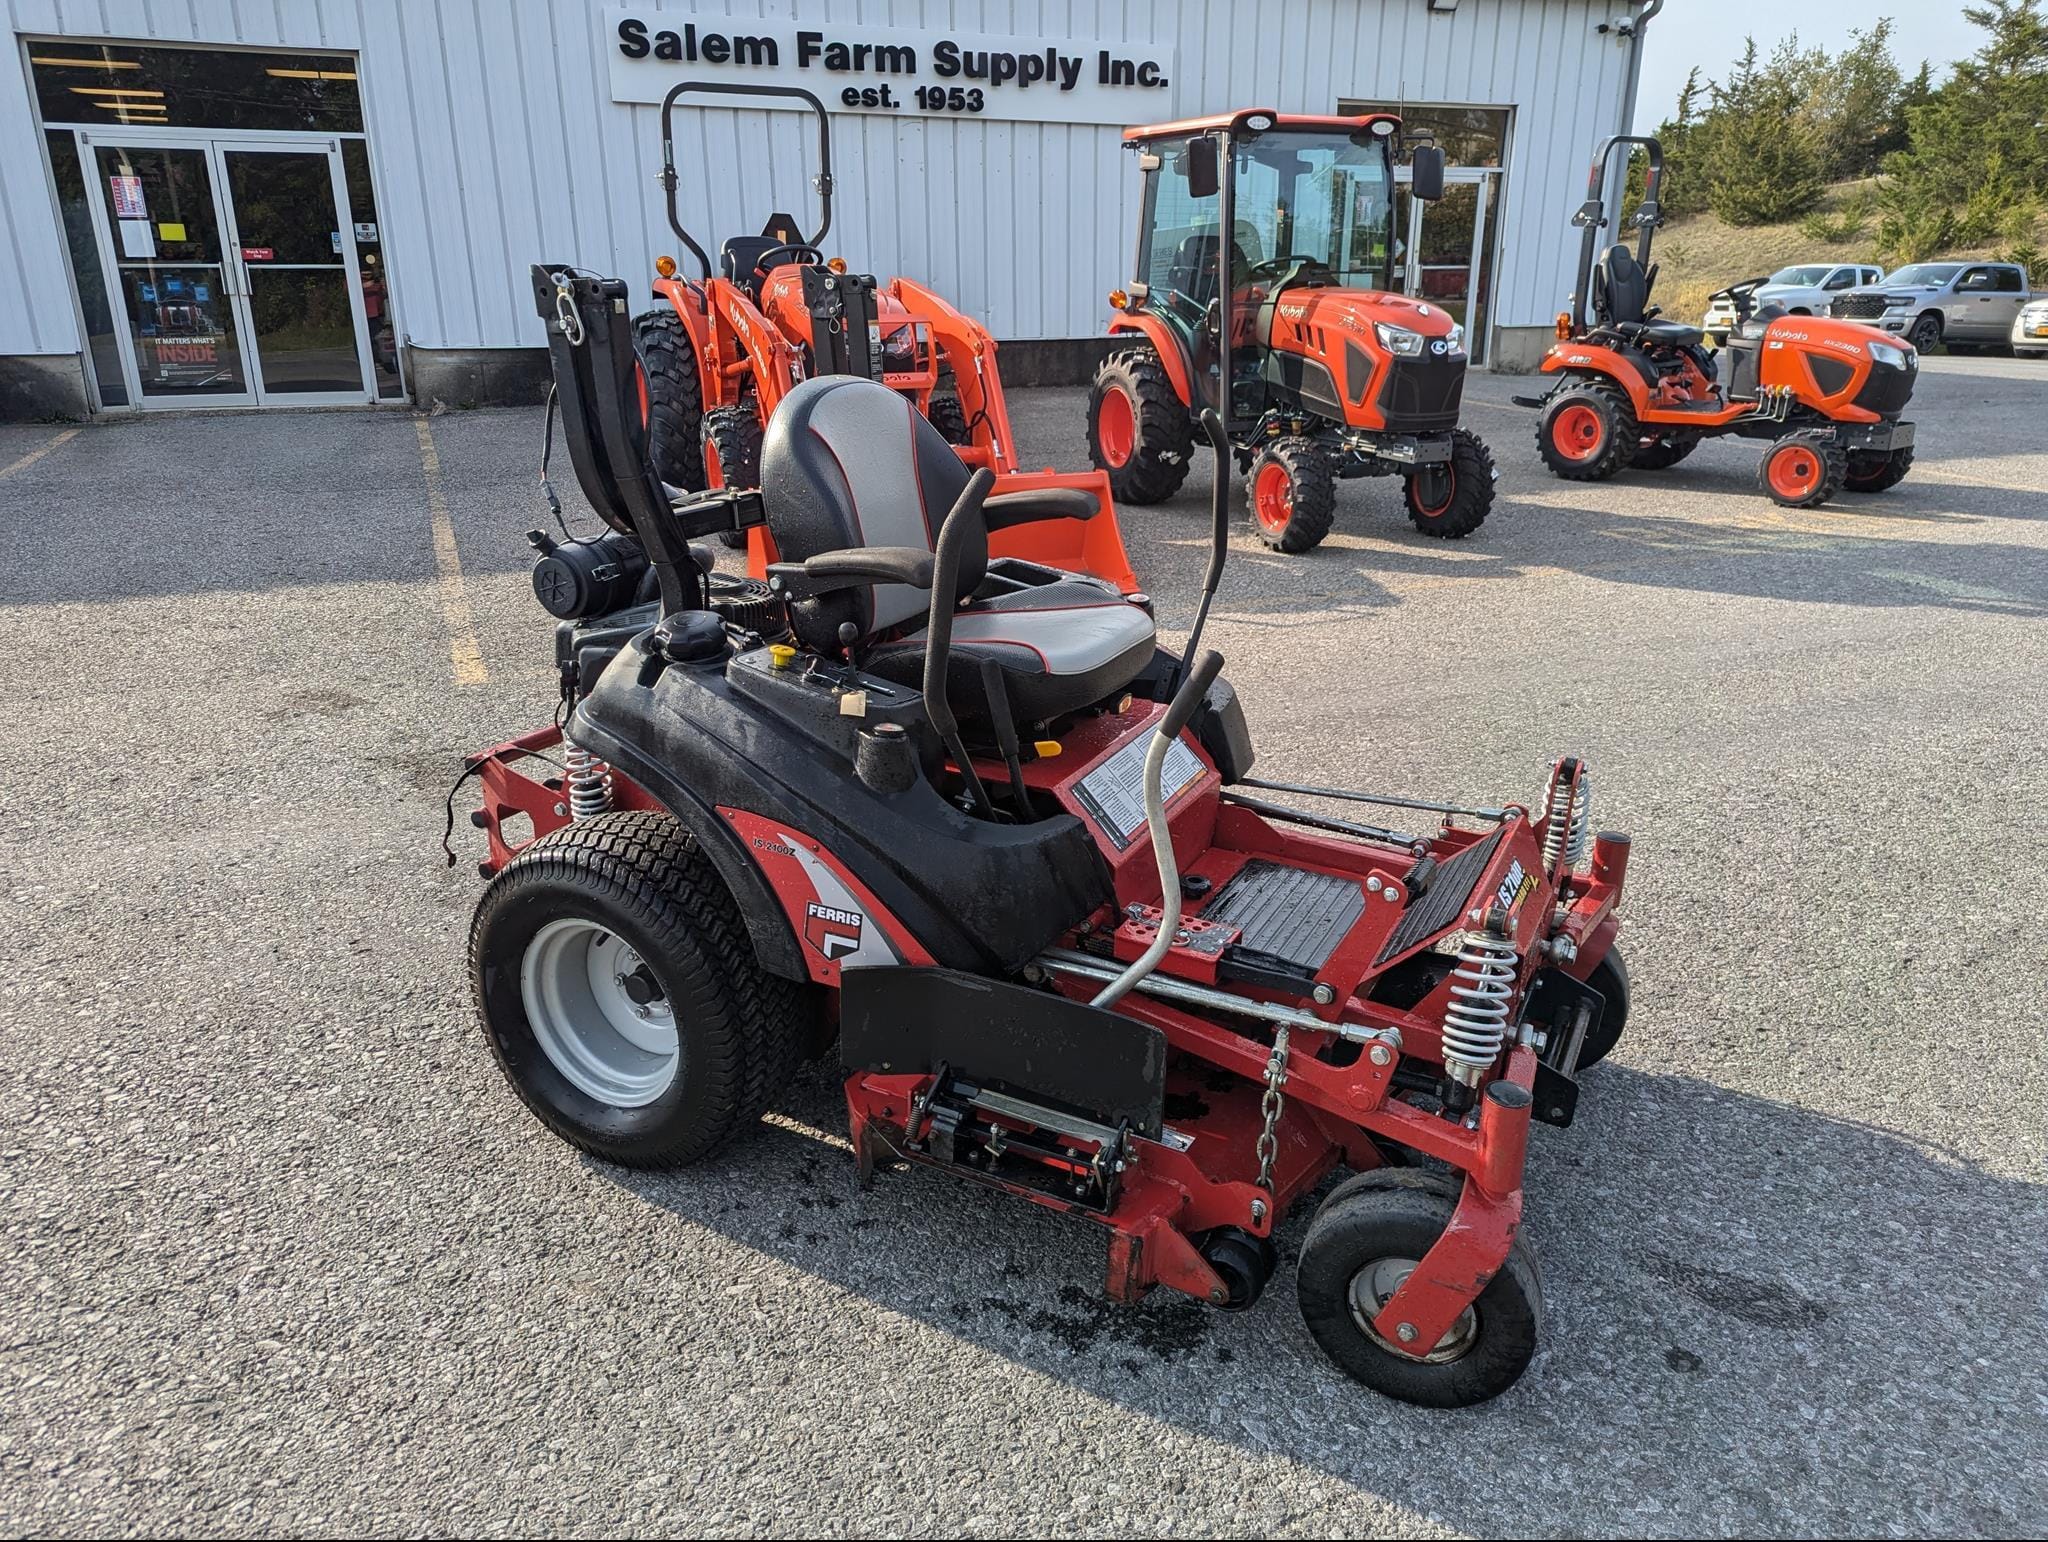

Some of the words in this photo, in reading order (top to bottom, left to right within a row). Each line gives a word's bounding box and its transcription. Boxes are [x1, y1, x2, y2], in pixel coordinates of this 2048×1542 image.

[618, 18, 779, 66] Salem
[796, 31, 916, 74] Farm
[933, 40, 1083, 90] Supply
[1099, 50, 1168, 88] Inc.
[841, 83, 900, 109] est.
[914, 85, 984, 112] 1953
[155, 337, 161, 345] IT
[162, 337, 191, 345] MATTERS
[1771, 328, 1809, 341] Kubota
[156, 344, 218, 362] INSIDE
[753, 838, 763, 848] IS
[808, 903, 861, 927] FERRIS
